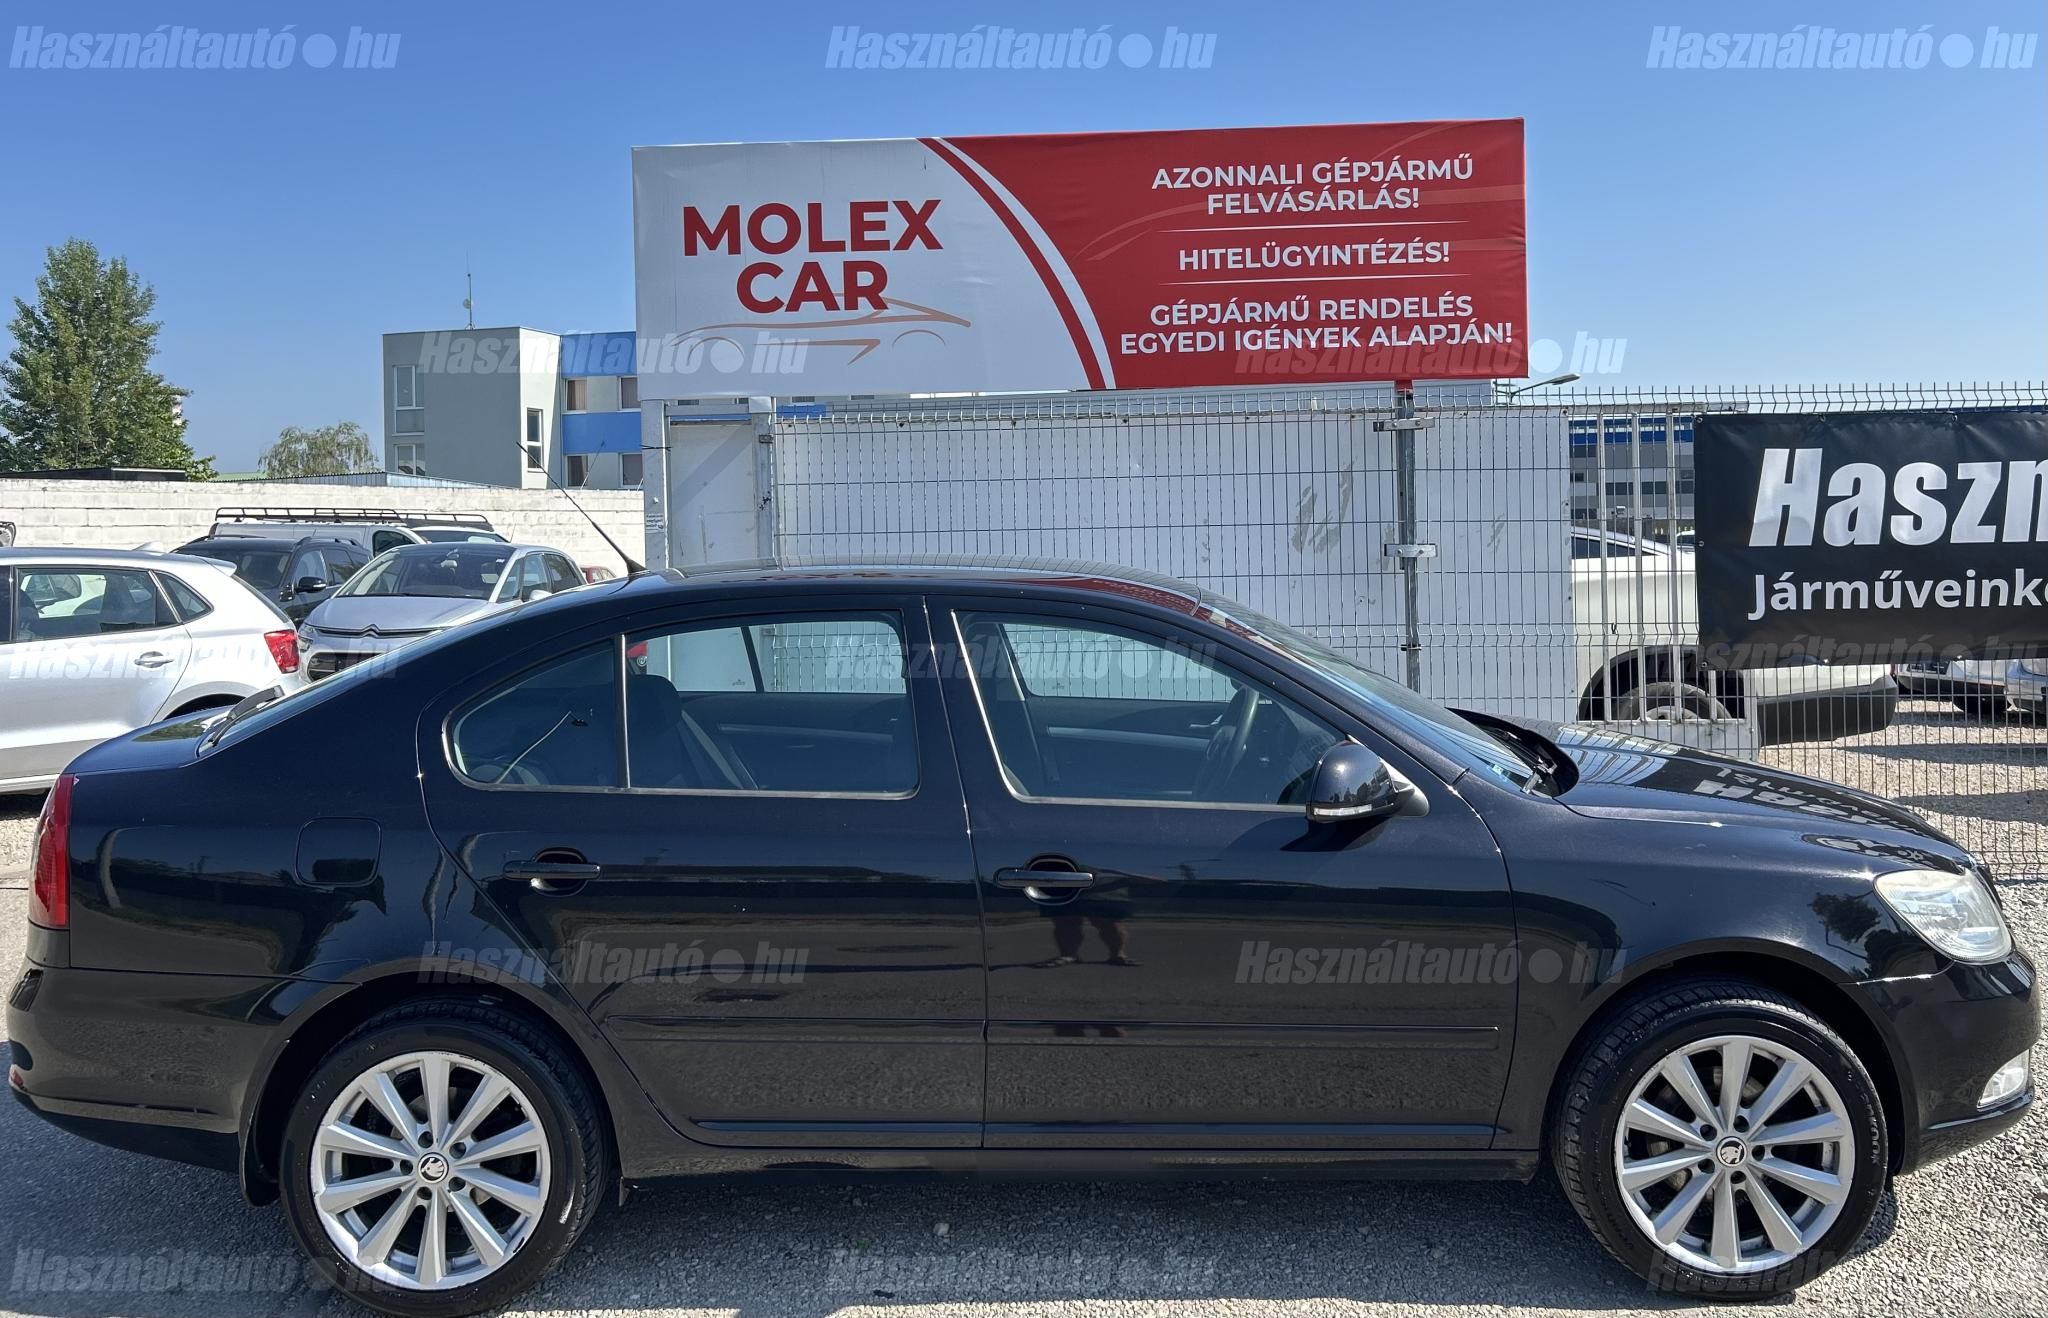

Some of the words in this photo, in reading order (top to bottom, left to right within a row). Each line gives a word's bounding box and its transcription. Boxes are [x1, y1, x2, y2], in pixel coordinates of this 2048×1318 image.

[1151, 163, 1303, 190] AZONNALI
[1311, 153, 1473, 184] GÉPJÁRMŰ
[1207, 183, 1420, 215] FELVÁSÁRLÁS!
[683, 199, 944, 256] MOLEX
[1178, 237, 1450, 271] HITELÜGYINTÉZÉS!
[736, 260, 889, 314] CAR
[1150, 294, 1310, 326] GÉPJÁRMŰ
[1319, 290, 1473, 321] RENDELÉS
[1120, 330, 1225, 355] EGYEDI
[1235, 323, 1361, 351] IGÉNYEK
[1368, 317, 1513, 347] ALAPJÁN!
[1748, 446, 2048, 547] Haszn
[1747, 568, 2048, 621] Járműveink
